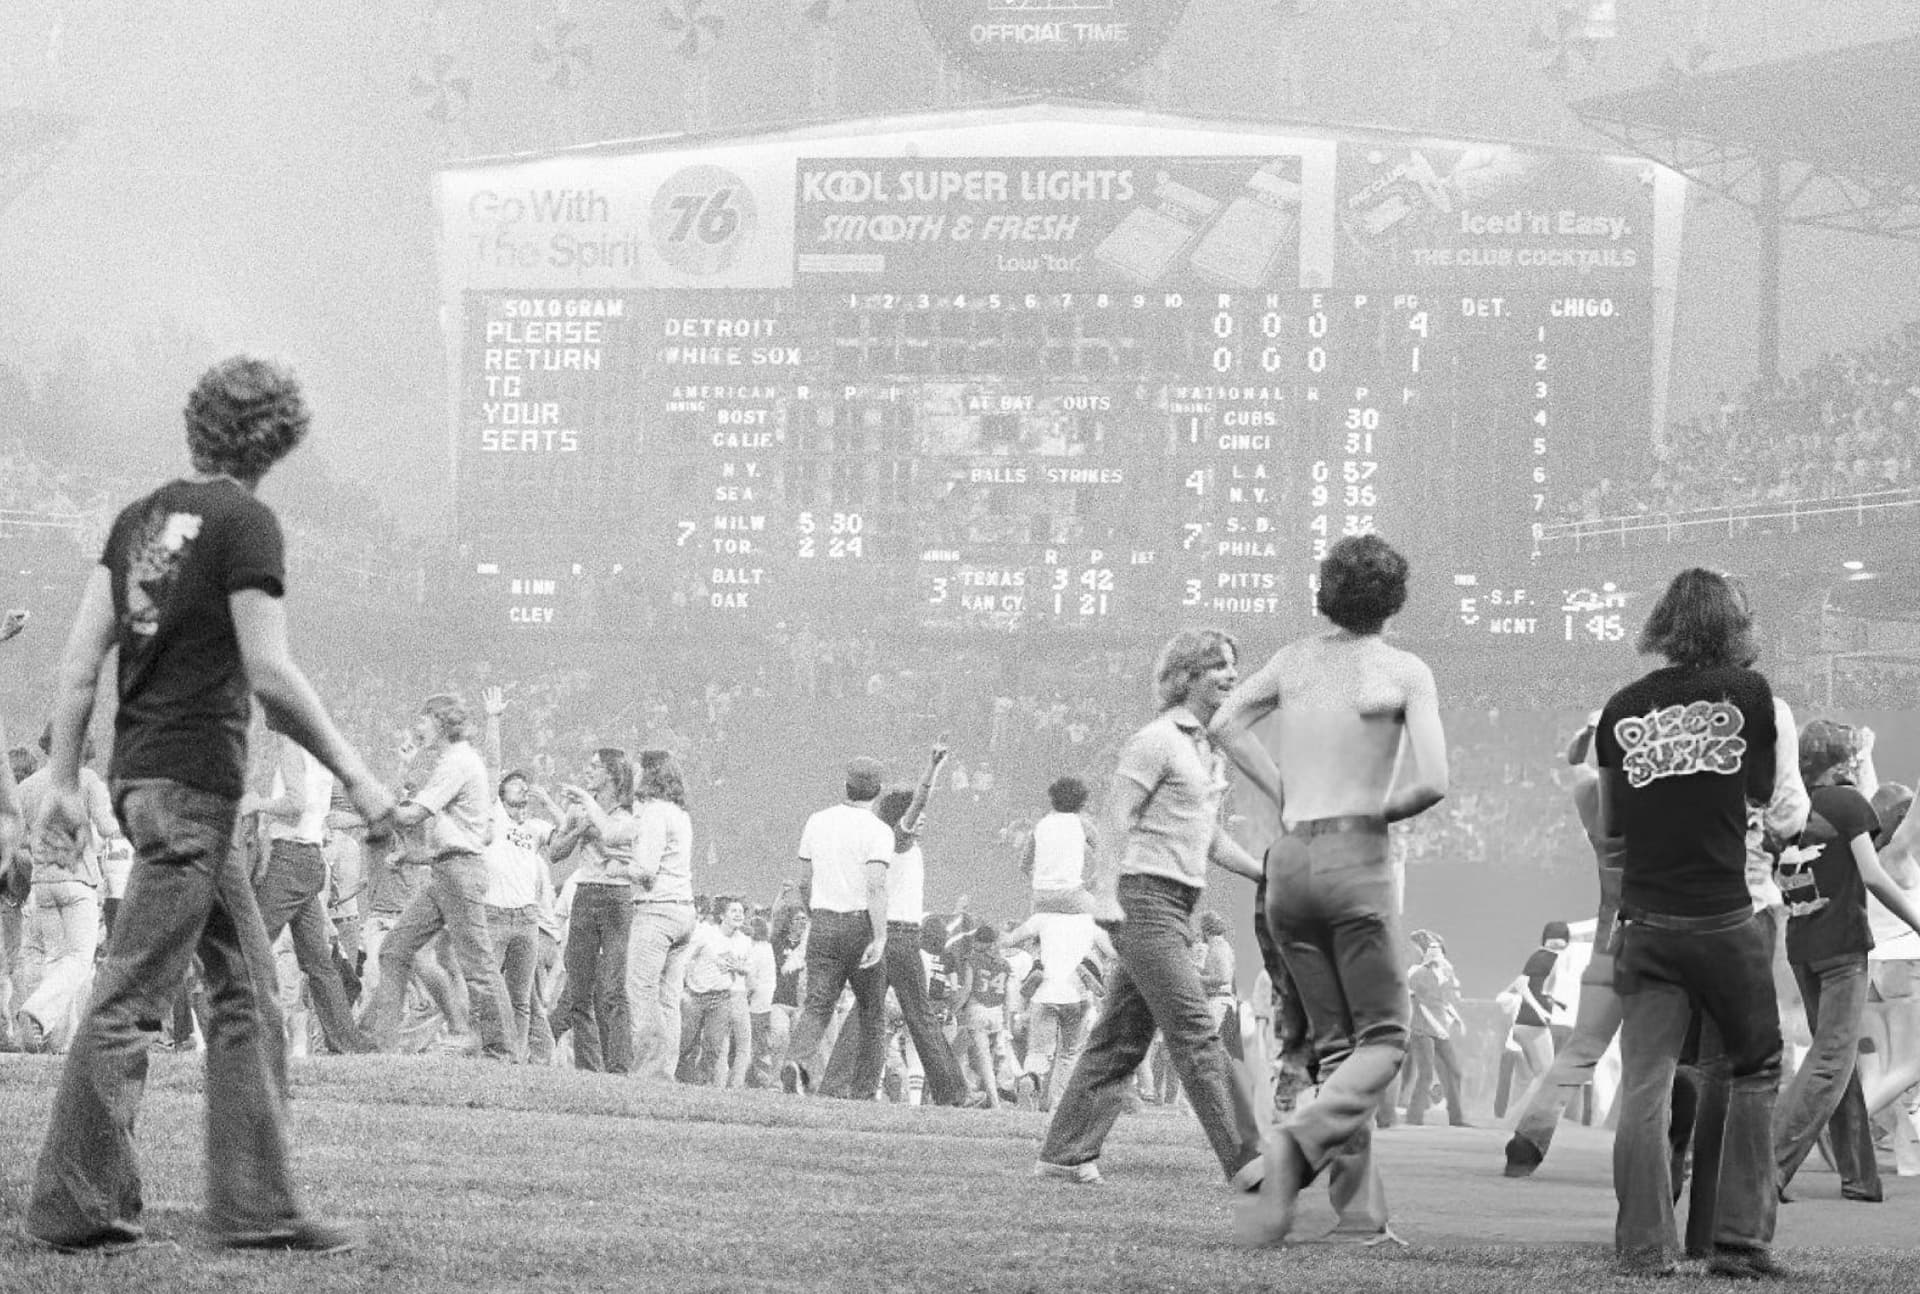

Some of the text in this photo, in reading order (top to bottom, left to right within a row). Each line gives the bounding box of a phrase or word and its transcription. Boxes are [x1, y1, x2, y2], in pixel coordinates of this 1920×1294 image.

[970, 23, 1128, 43] OFFICIAL TIME
[803, 169, 1134, 202] KOOL SUPER LIGHTS
[468, 189, 609, 225] Go With
[668, 189, 738, 245] 76
[818, 214, 1080, 242] SMOOTH & FRESH
[1460, 210, 1523, 235] Iced
[1558, 210, 1632, 240] Easy.
[1412, 248, 1637, 267] THE CLUB COCKTAILS
[882, 294, 894, 308] 2
[918, 294, 929, 308] 3
[953, 294, 966, 308] 4
[989, 294, 1001, 308] 5
[1025, 294, 1037, 308] 6
[1061, 294, 1073, 308] 7
[1097, 294, 1109, 308] 8
[1132, 294, 1145, 308] 9
[1164, 294, 1183, 308] 10
[1218, 293, 1231, 309] R
[1312, 293, 1324, 309] E
[1354, 293, 1367, 309] P
[1461, 298, 1512, 317] DET.
[486, 321, 603, 344] PLEASE
[665, 311, 1428, 338] DETROIT 0 0 0 4
[1537, 326, 1545, 342] 1
[485, 349, 602, 371] RETURN
[665, 347, 742, 366] WHITE
[751, 347, 801, 366] SOX
[1213, 347, 1231, 373] 0
[1307, 347, 1326, 373] 0
[1411, 347, 1420, 373] 1
[1534, 353, 1548, 371] 2
[485, 376, 521, 398] TO
[672, 385, 857, 400] AMERICAN R P
[1355, 387, 1369, 401] P
[1535, 381, 1548, 399] 3
[1000, 395, 1034, 410] BAT
[1063, 396, 1111, 410] OUTS
[482, 402, 560, 425] YOUR
[717, 409, 767, 425] BOST
[1223, 411, 1276, 427] CUBS
[1345, 408, 1379, 430] 30
[1533, 410, 1547, 427] 4
[482, 430, 578, 451] SEATS
[1218, 432, 1373, 454] CINCI 31
[1533, 437, 1546, 456] 5
[970, 468, 1123, 483] BALLS STRIKES
[1185, 470, 1204, 495] 4
[1343, 461, 1378, 483] 57
[1532, 467, 1546, 483] 6
[1311, 485, 1328, 507] 9
[1532, 494, 1545, 511] 7
[677, 511, 863, 546] 7 MILW 5 30
[1183, 523, 1203, 549] 7
[1310, 514, 1328, 537] 4
[799, 536, 815, 558] 2
[829, 536, 862, 558] 24
[1045, 550, 1057, 564] R
[1091, 550, 1104, 564] P
[1218, 542, 1276, 557] PHILA
[712, 568, 764, 585] BALT
[930, 568, 1114, 604] 3 TEXAS 3 42
[1182, 573, 1275, 606] 3 PITTS
[710, 592, 749, 608] OAK
[1054, 593, 1062, 615] 1
[1079, 593, 1108, 615] 21
[1213, 597, 1279, 613] HOUST
[509, 606, 555, 623] CLEV
[1586, 614, 1625, 641] 45
